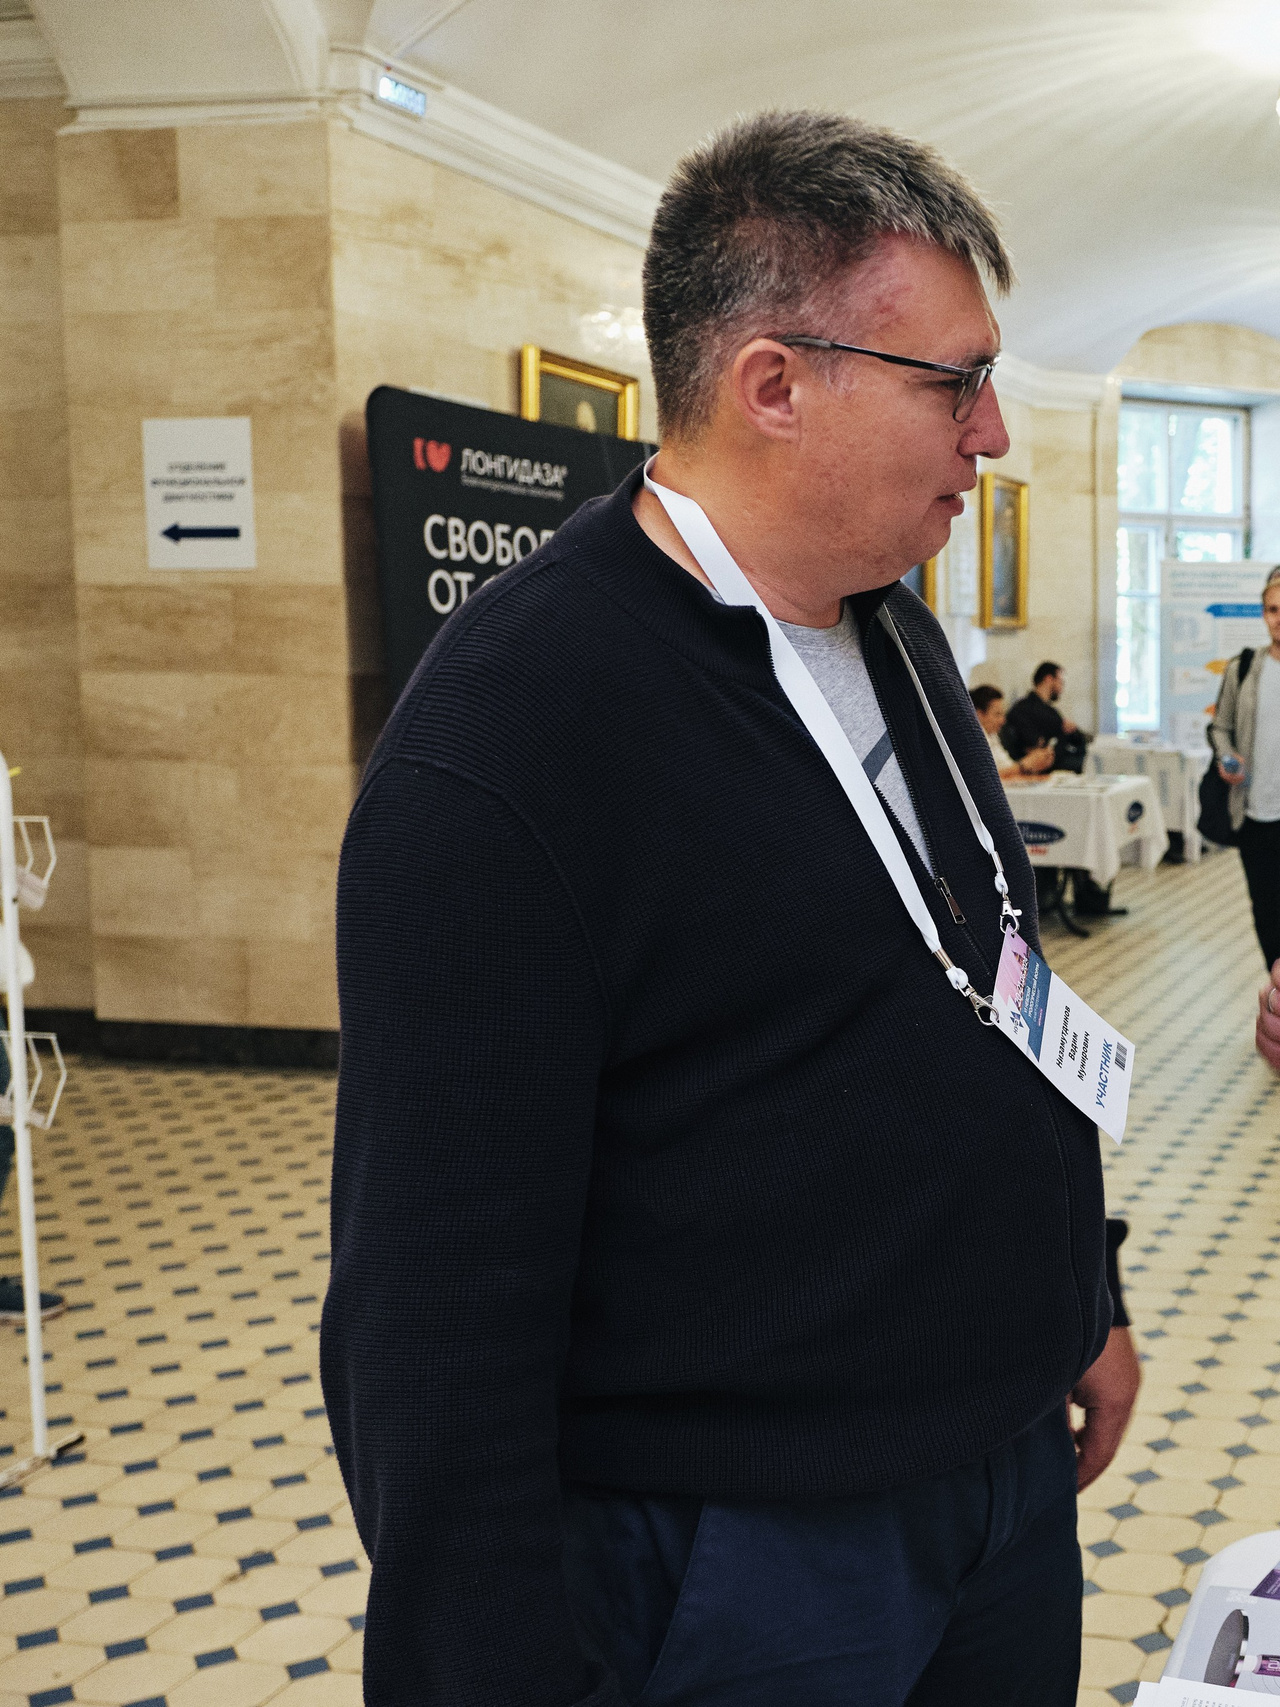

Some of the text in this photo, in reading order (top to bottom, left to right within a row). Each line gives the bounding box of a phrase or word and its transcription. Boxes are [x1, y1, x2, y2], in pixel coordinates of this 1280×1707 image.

[1055, 1006, 1071, 1068] Низамутдинов
[1069, 1032, 1078, 1061] Вадим
[1077, 1031, 1090, 1081] Мунирович
[1095, 1039, 1113, 1108] УЧАСТНИК
